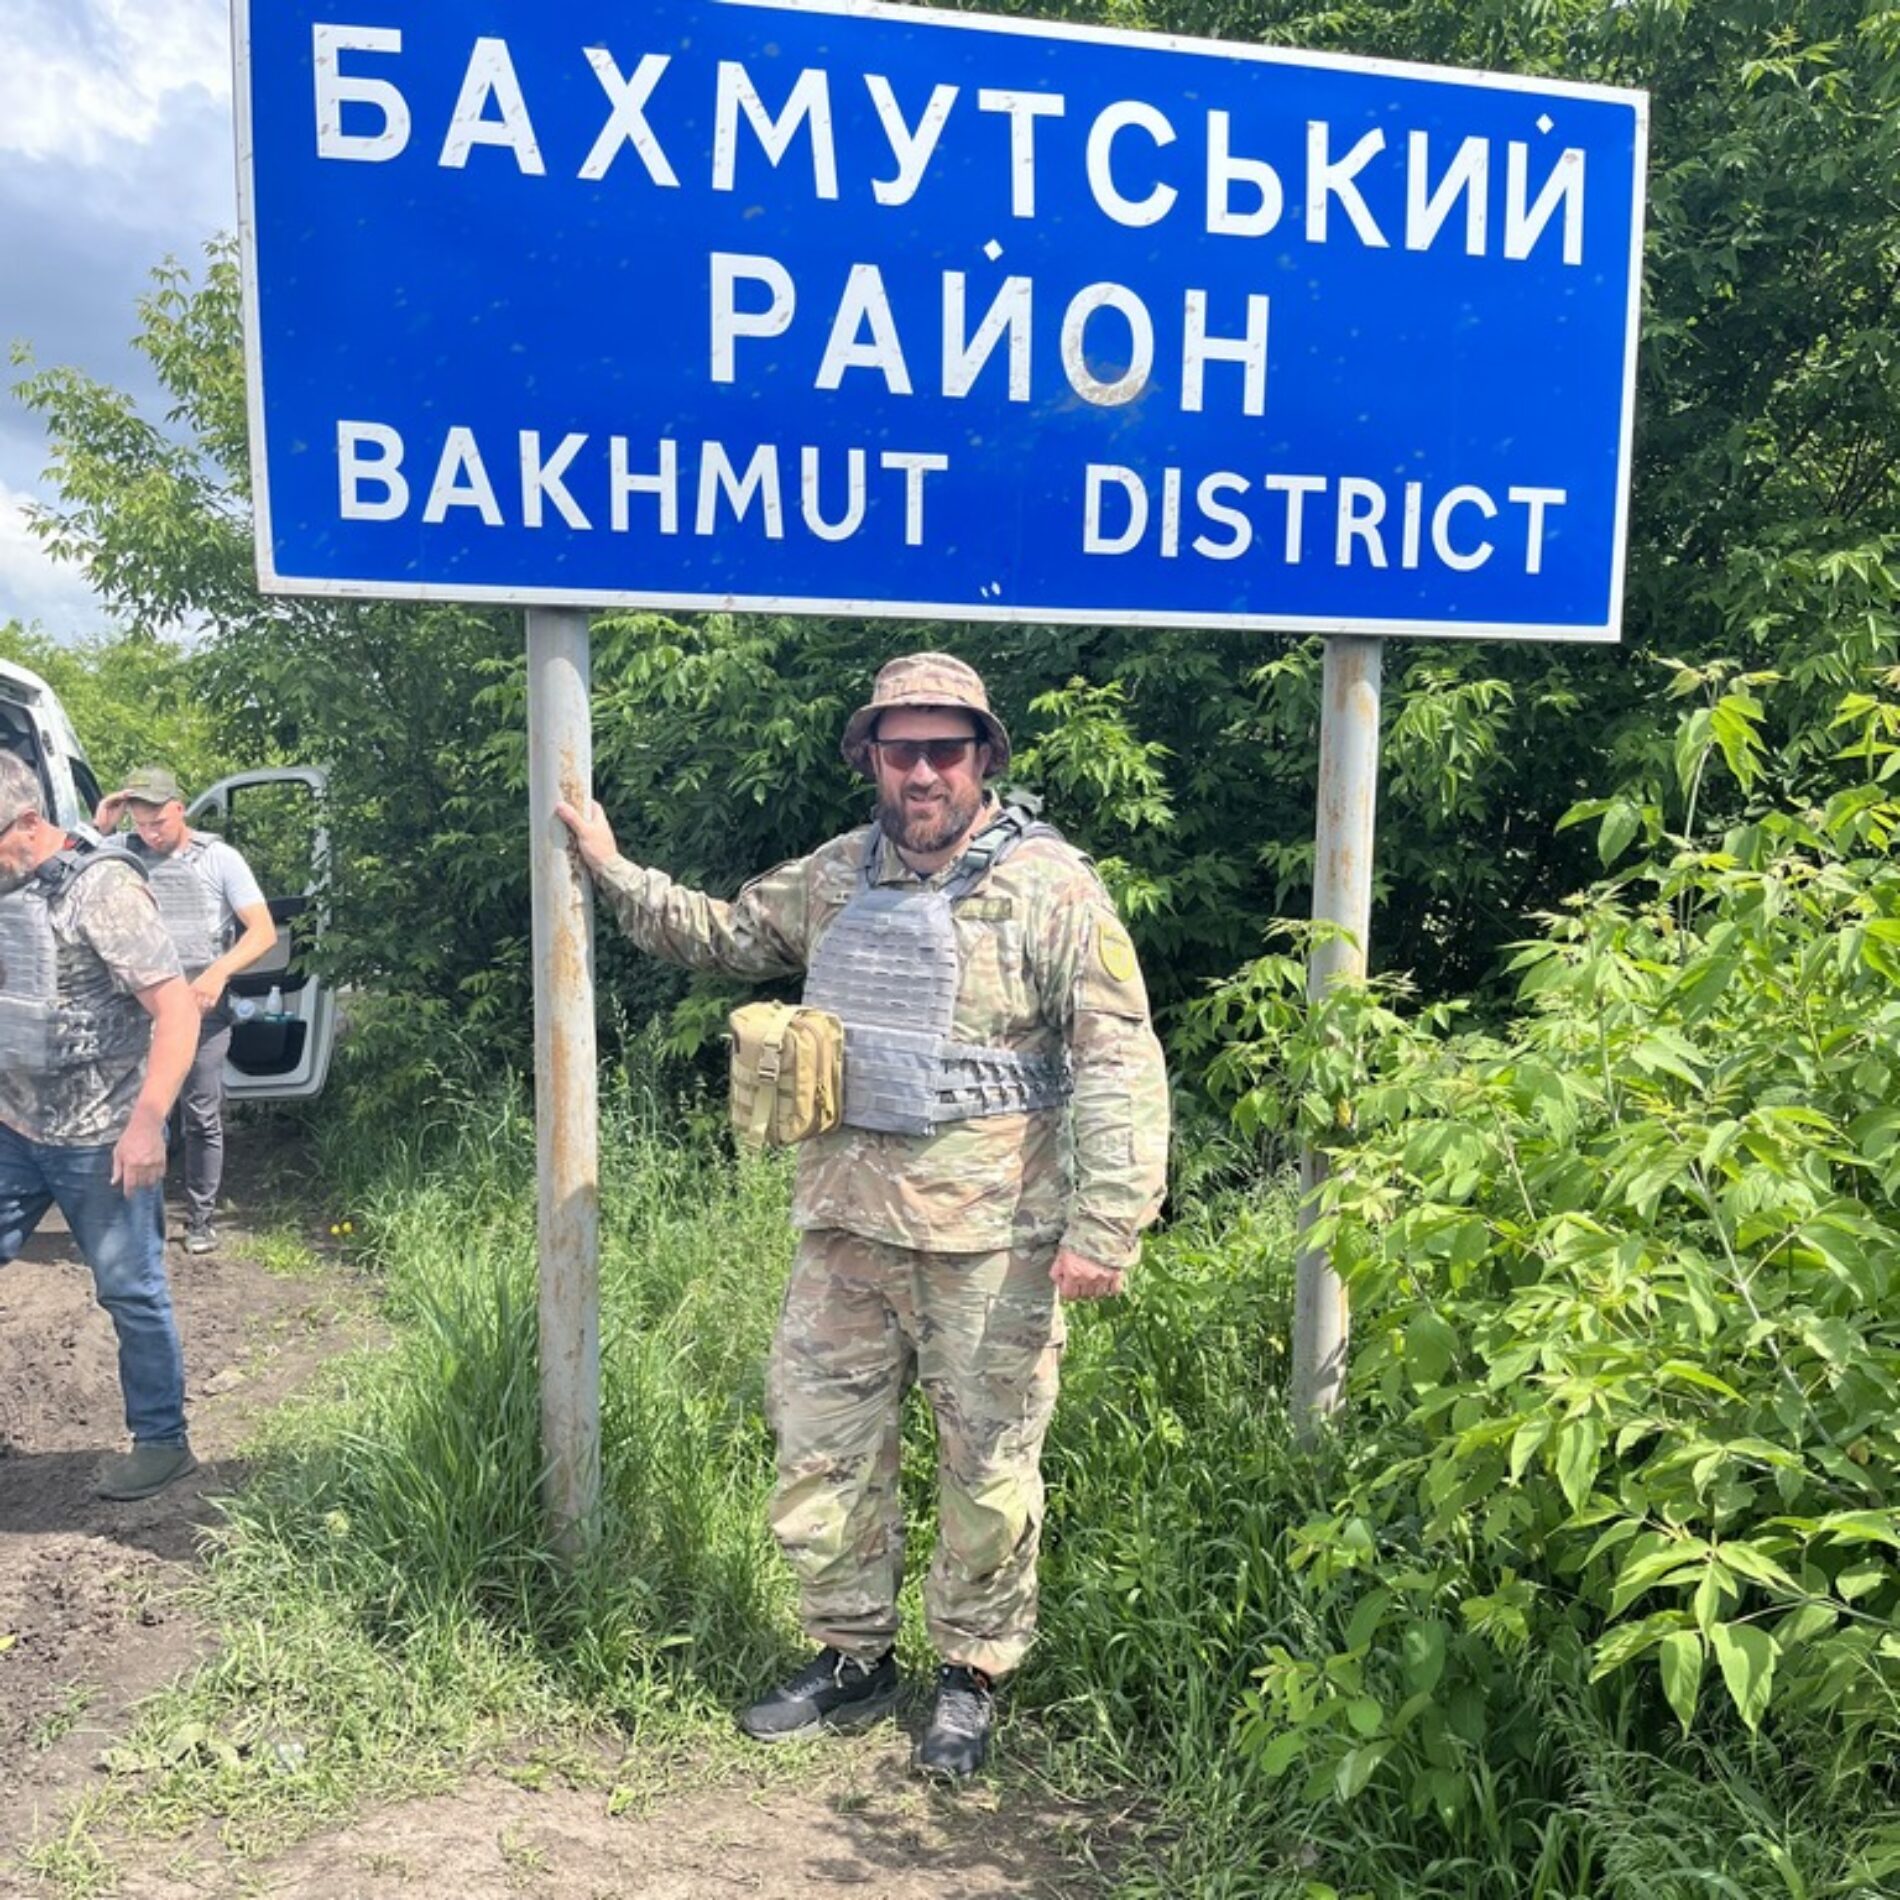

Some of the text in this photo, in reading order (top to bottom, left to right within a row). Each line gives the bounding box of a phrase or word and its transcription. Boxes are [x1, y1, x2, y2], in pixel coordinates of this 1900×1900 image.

[313, 23, 1585, 265] БАХМУТСЬКИЙ
[710, 239, 1269, 416] РАЙОН
[337, 420, 1567, 574] BAKHMUT DISTRICT
